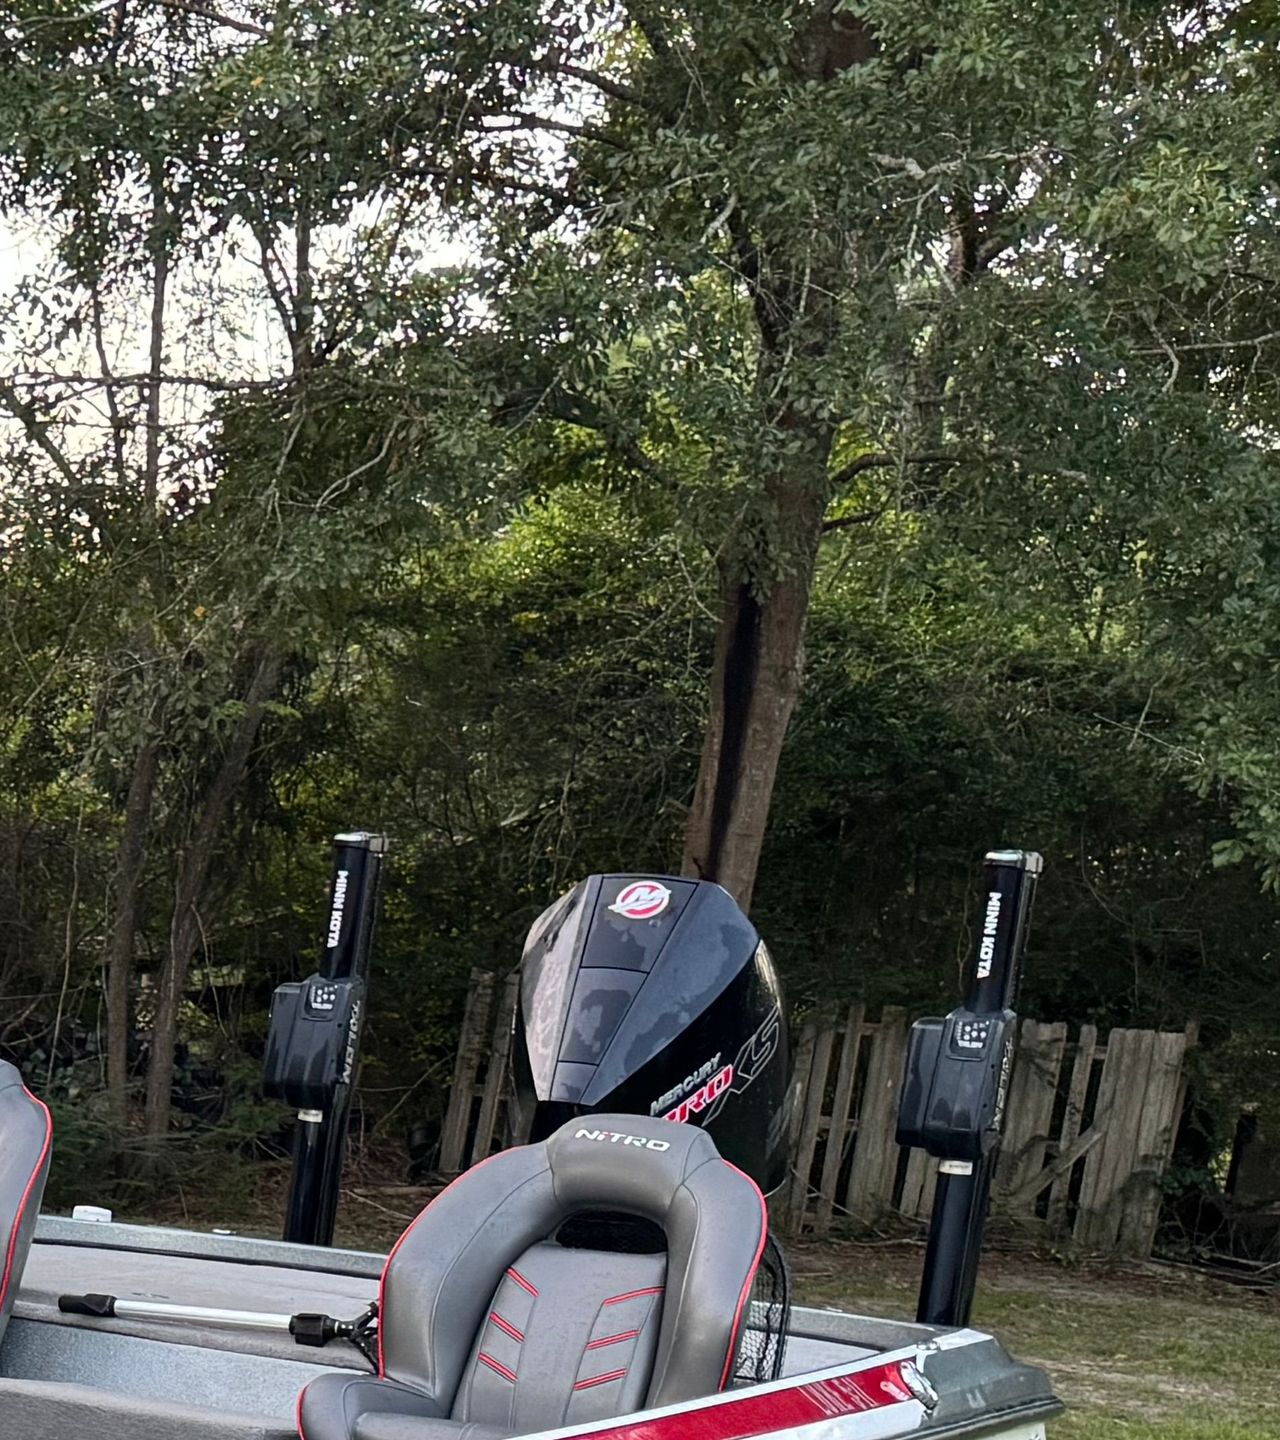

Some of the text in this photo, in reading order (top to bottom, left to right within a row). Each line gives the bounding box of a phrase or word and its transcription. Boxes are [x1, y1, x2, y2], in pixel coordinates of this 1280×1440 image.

[326, 869, 349, 949] MINN KOTA
[976, 891, 1002, 979] MINN KOTA
[650, 1051, 722, 1116] MERCURY
